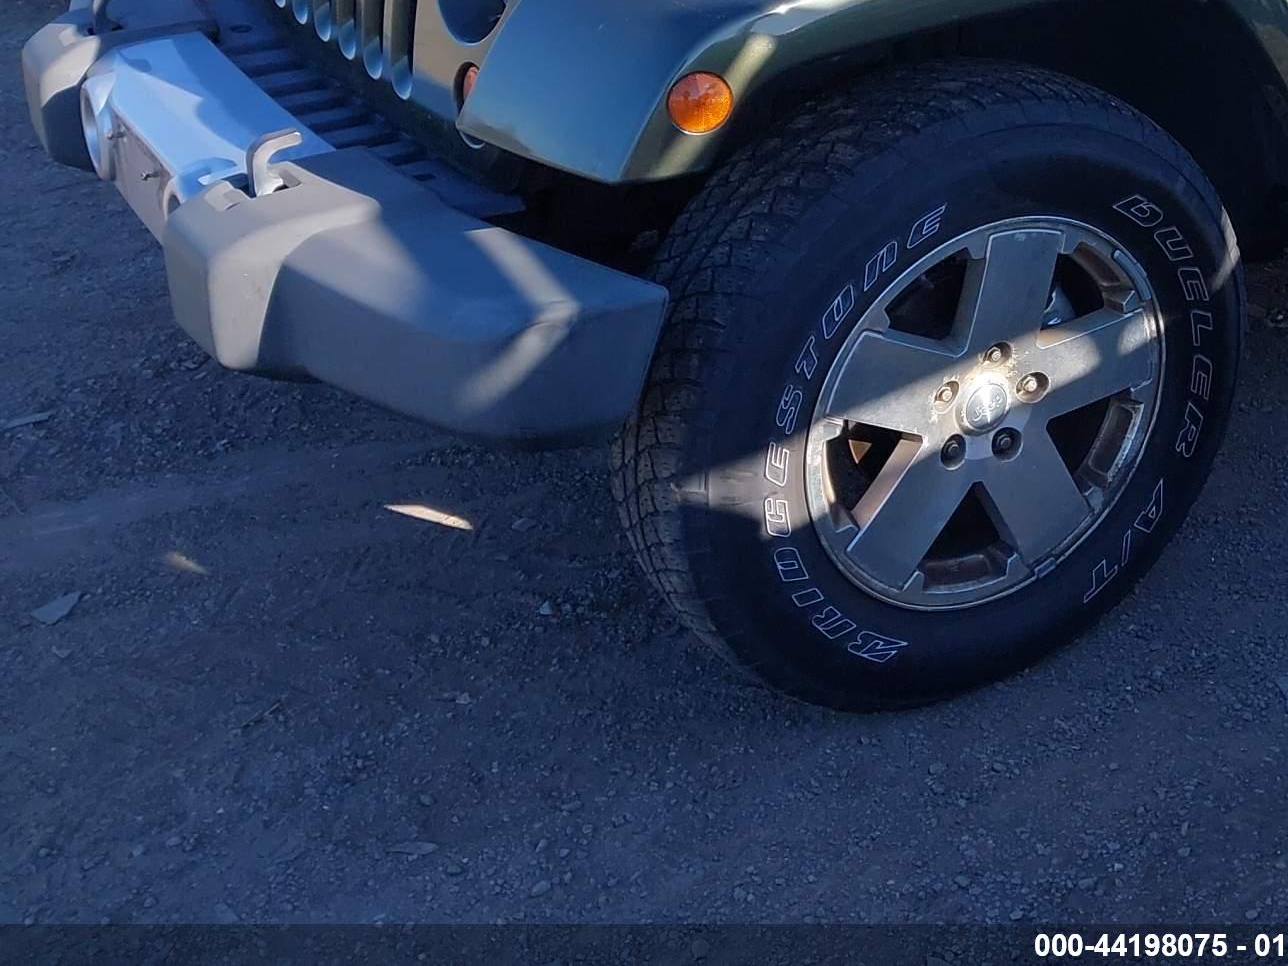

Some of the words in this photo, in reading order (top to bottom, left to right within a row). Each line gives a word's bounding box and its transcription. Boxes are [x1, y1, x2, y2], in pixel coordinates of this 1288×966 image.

[763, 202, 948, 663] BRIDGESTONE
[1112, 193, 1215, 458] DUELER
[1083, 479, 1165, 603] A/T
